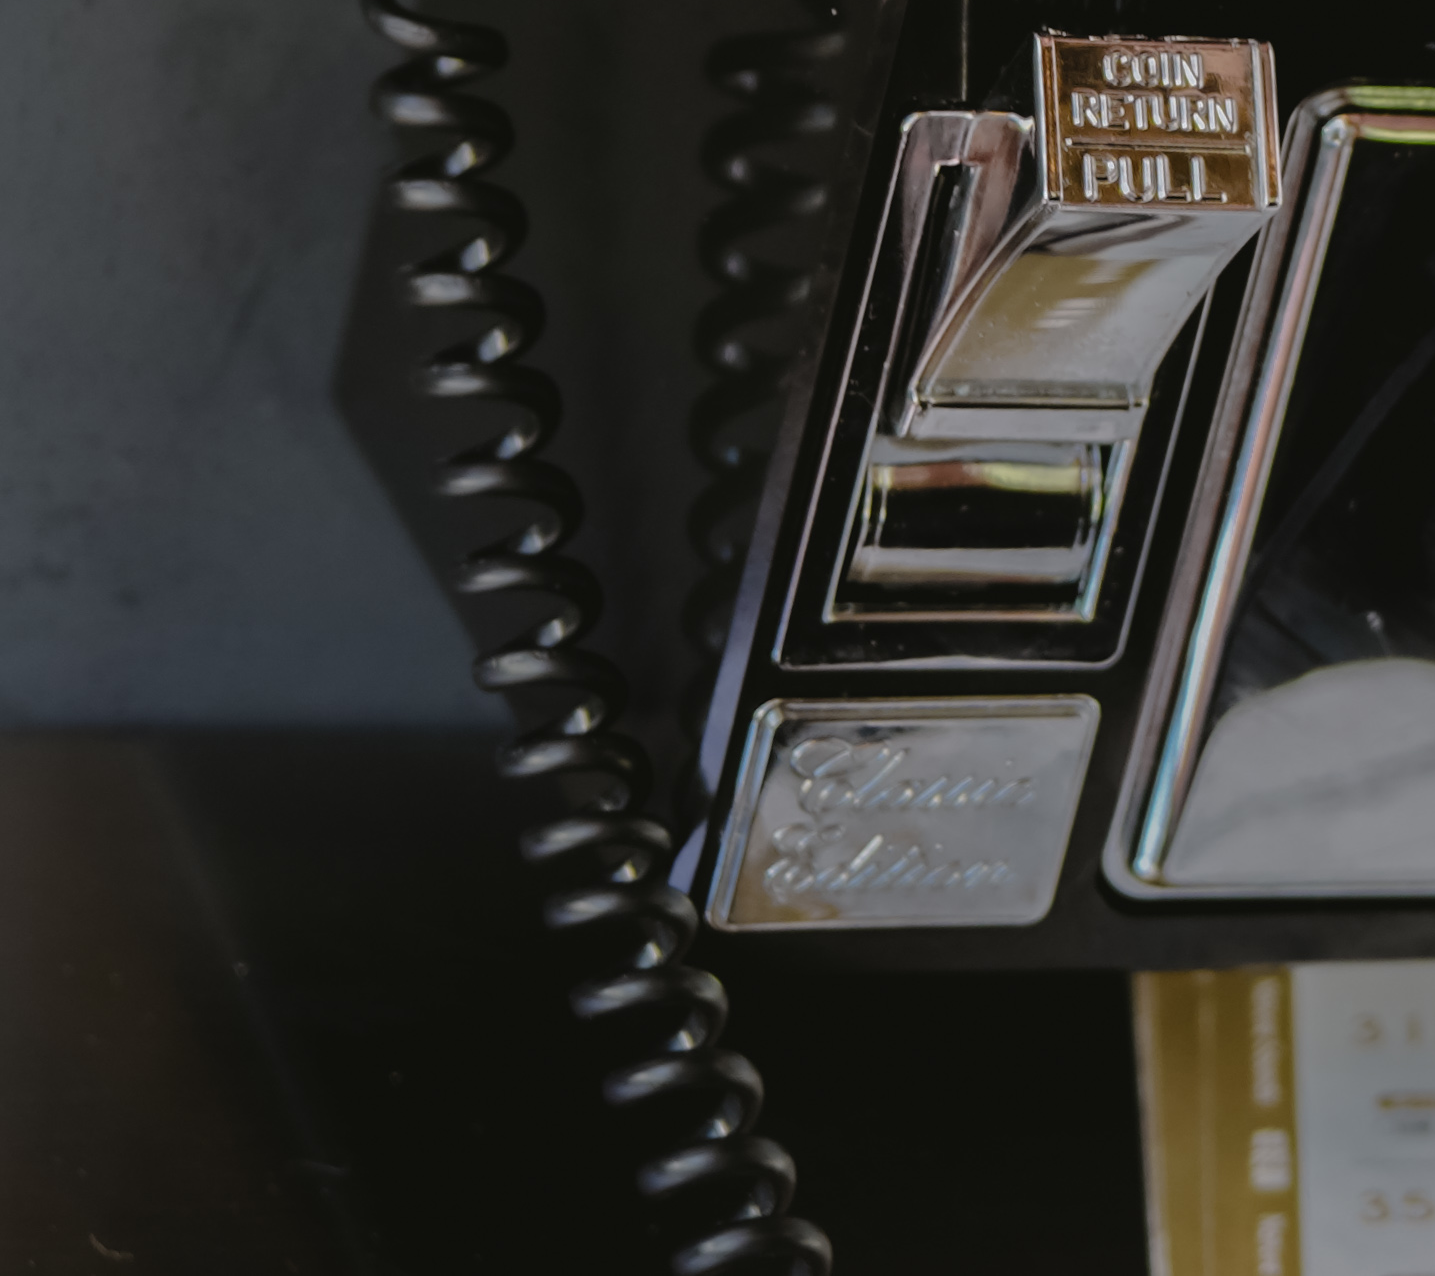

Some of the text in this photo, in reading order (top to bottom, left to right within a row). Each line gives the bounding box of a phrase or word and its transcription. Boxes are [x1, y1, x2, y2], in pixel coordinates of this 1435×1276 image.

[1101, 48, 1207, 89] COIN
[1070, 89, 1239, 135] RETURN
[1080, 153, 1229, 204] PULL
